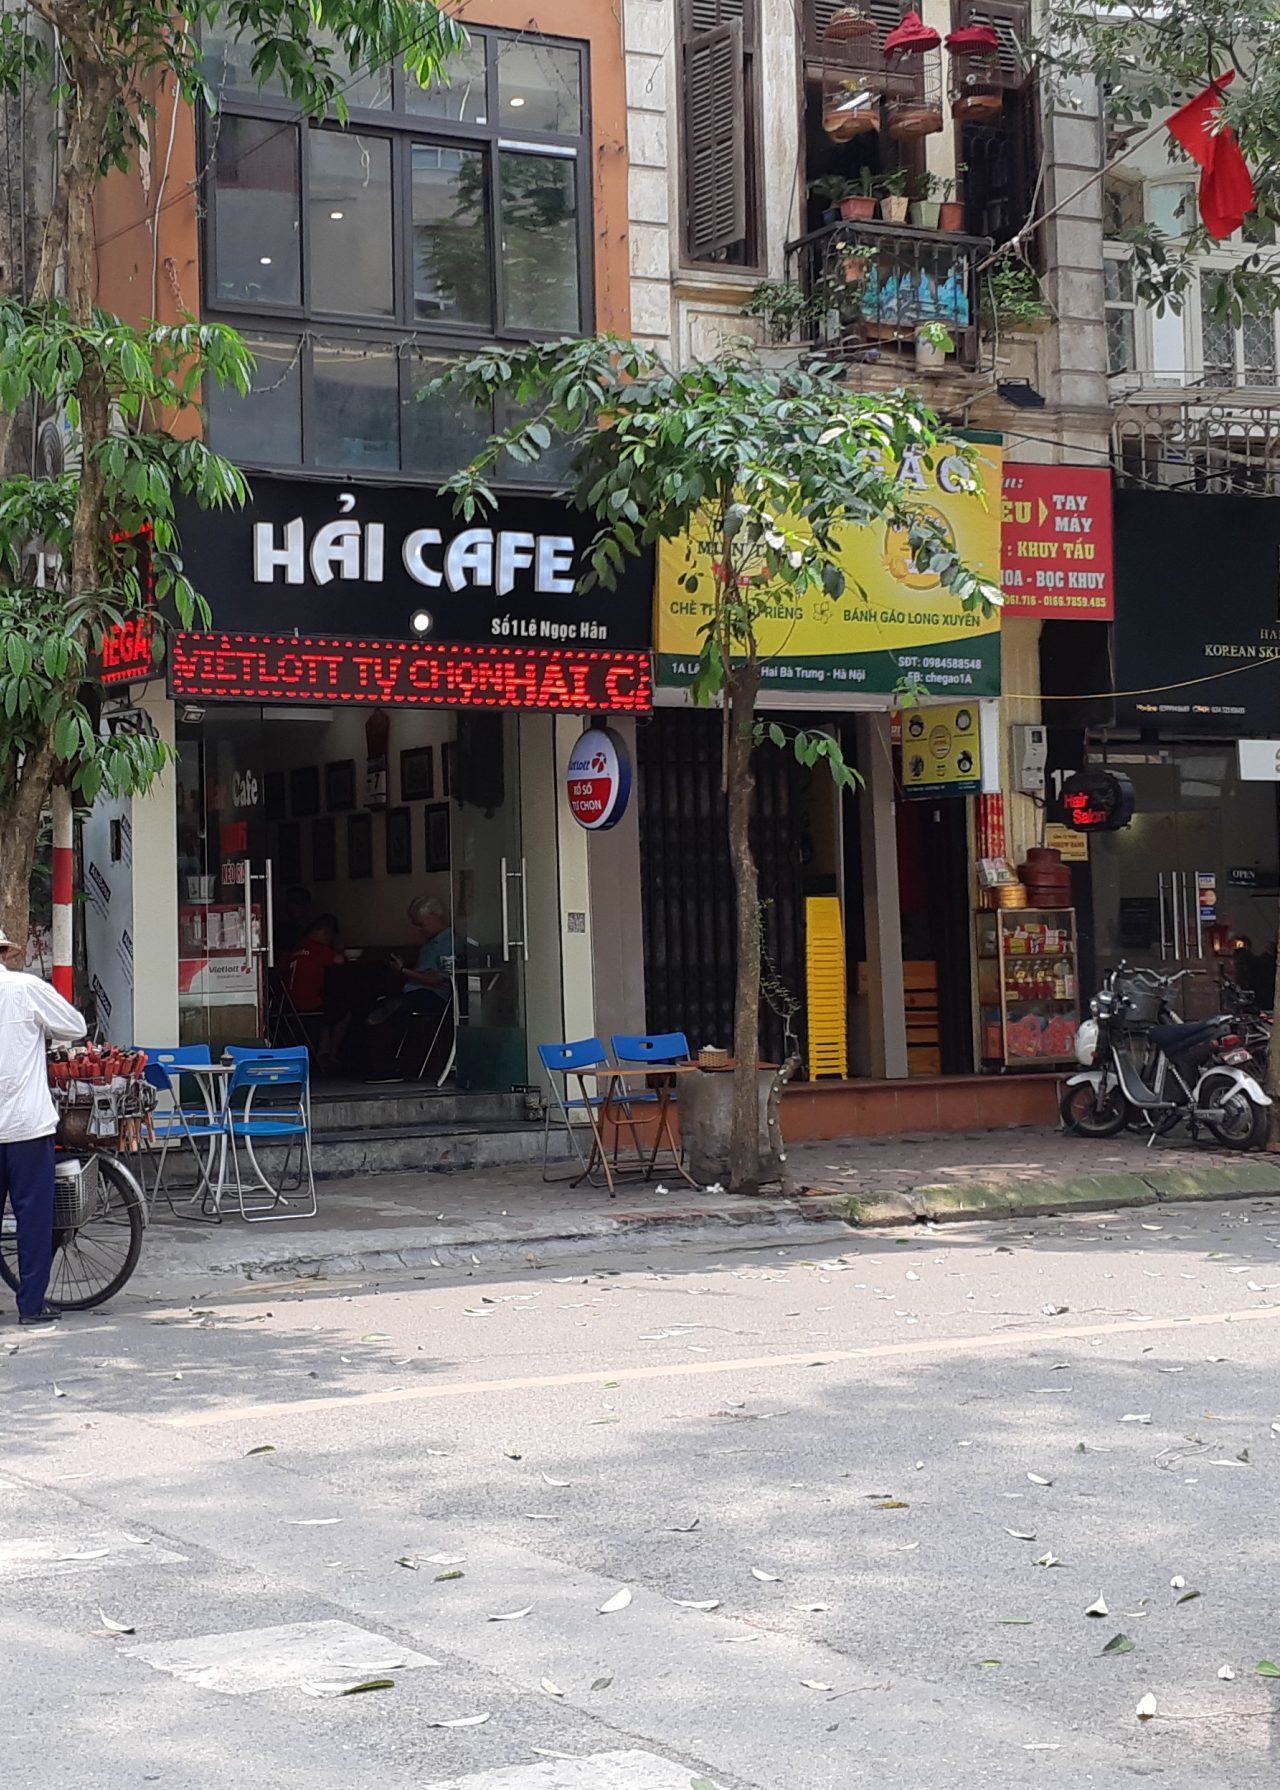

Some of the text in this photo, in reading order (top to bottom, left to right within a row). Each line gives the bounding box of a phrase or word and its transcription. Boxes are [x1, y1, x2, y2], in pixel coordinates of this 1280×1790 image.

[1052, 494, 1088, 511] TAY
[1054, 513, 1093, 533] MÁY
[253, 492, 576, 597] HẢI CAFE
[1017, 541, 1059, 558] KHUY
[1036, 570, 1064, 592] BỌC
[1068, 571, 1105, 590] KHUY
[670, 600, 697, 616] CHÈ
[843, 607, 877, 623] BÁNH
[908, 612, 939, 625] LONG
[942, 612, 981, 627] XUYÊN
[540, 620, 577, 642] Ngọc
[580, 620, 608, 640] Hân
[102, 616, 148, 668] EGA
[1204, 644, 1257, 658] KOREAN
[761, 666, 777, 678] Hai
[779, 666, 794, 678] Bà
[795, 667, 824, 681] Trưng
[832, 667, 847, 680] Hà
[848, 667, 866, 682] Nội
[924, 673, 973, 686] chegao1A
[232, 769, 258, 807] Cafe
[1064, 792, 1089, 808] Hair
[1232, 870, 1255, 879] OPEN
[209, 965, 239, 973] Vietlott
